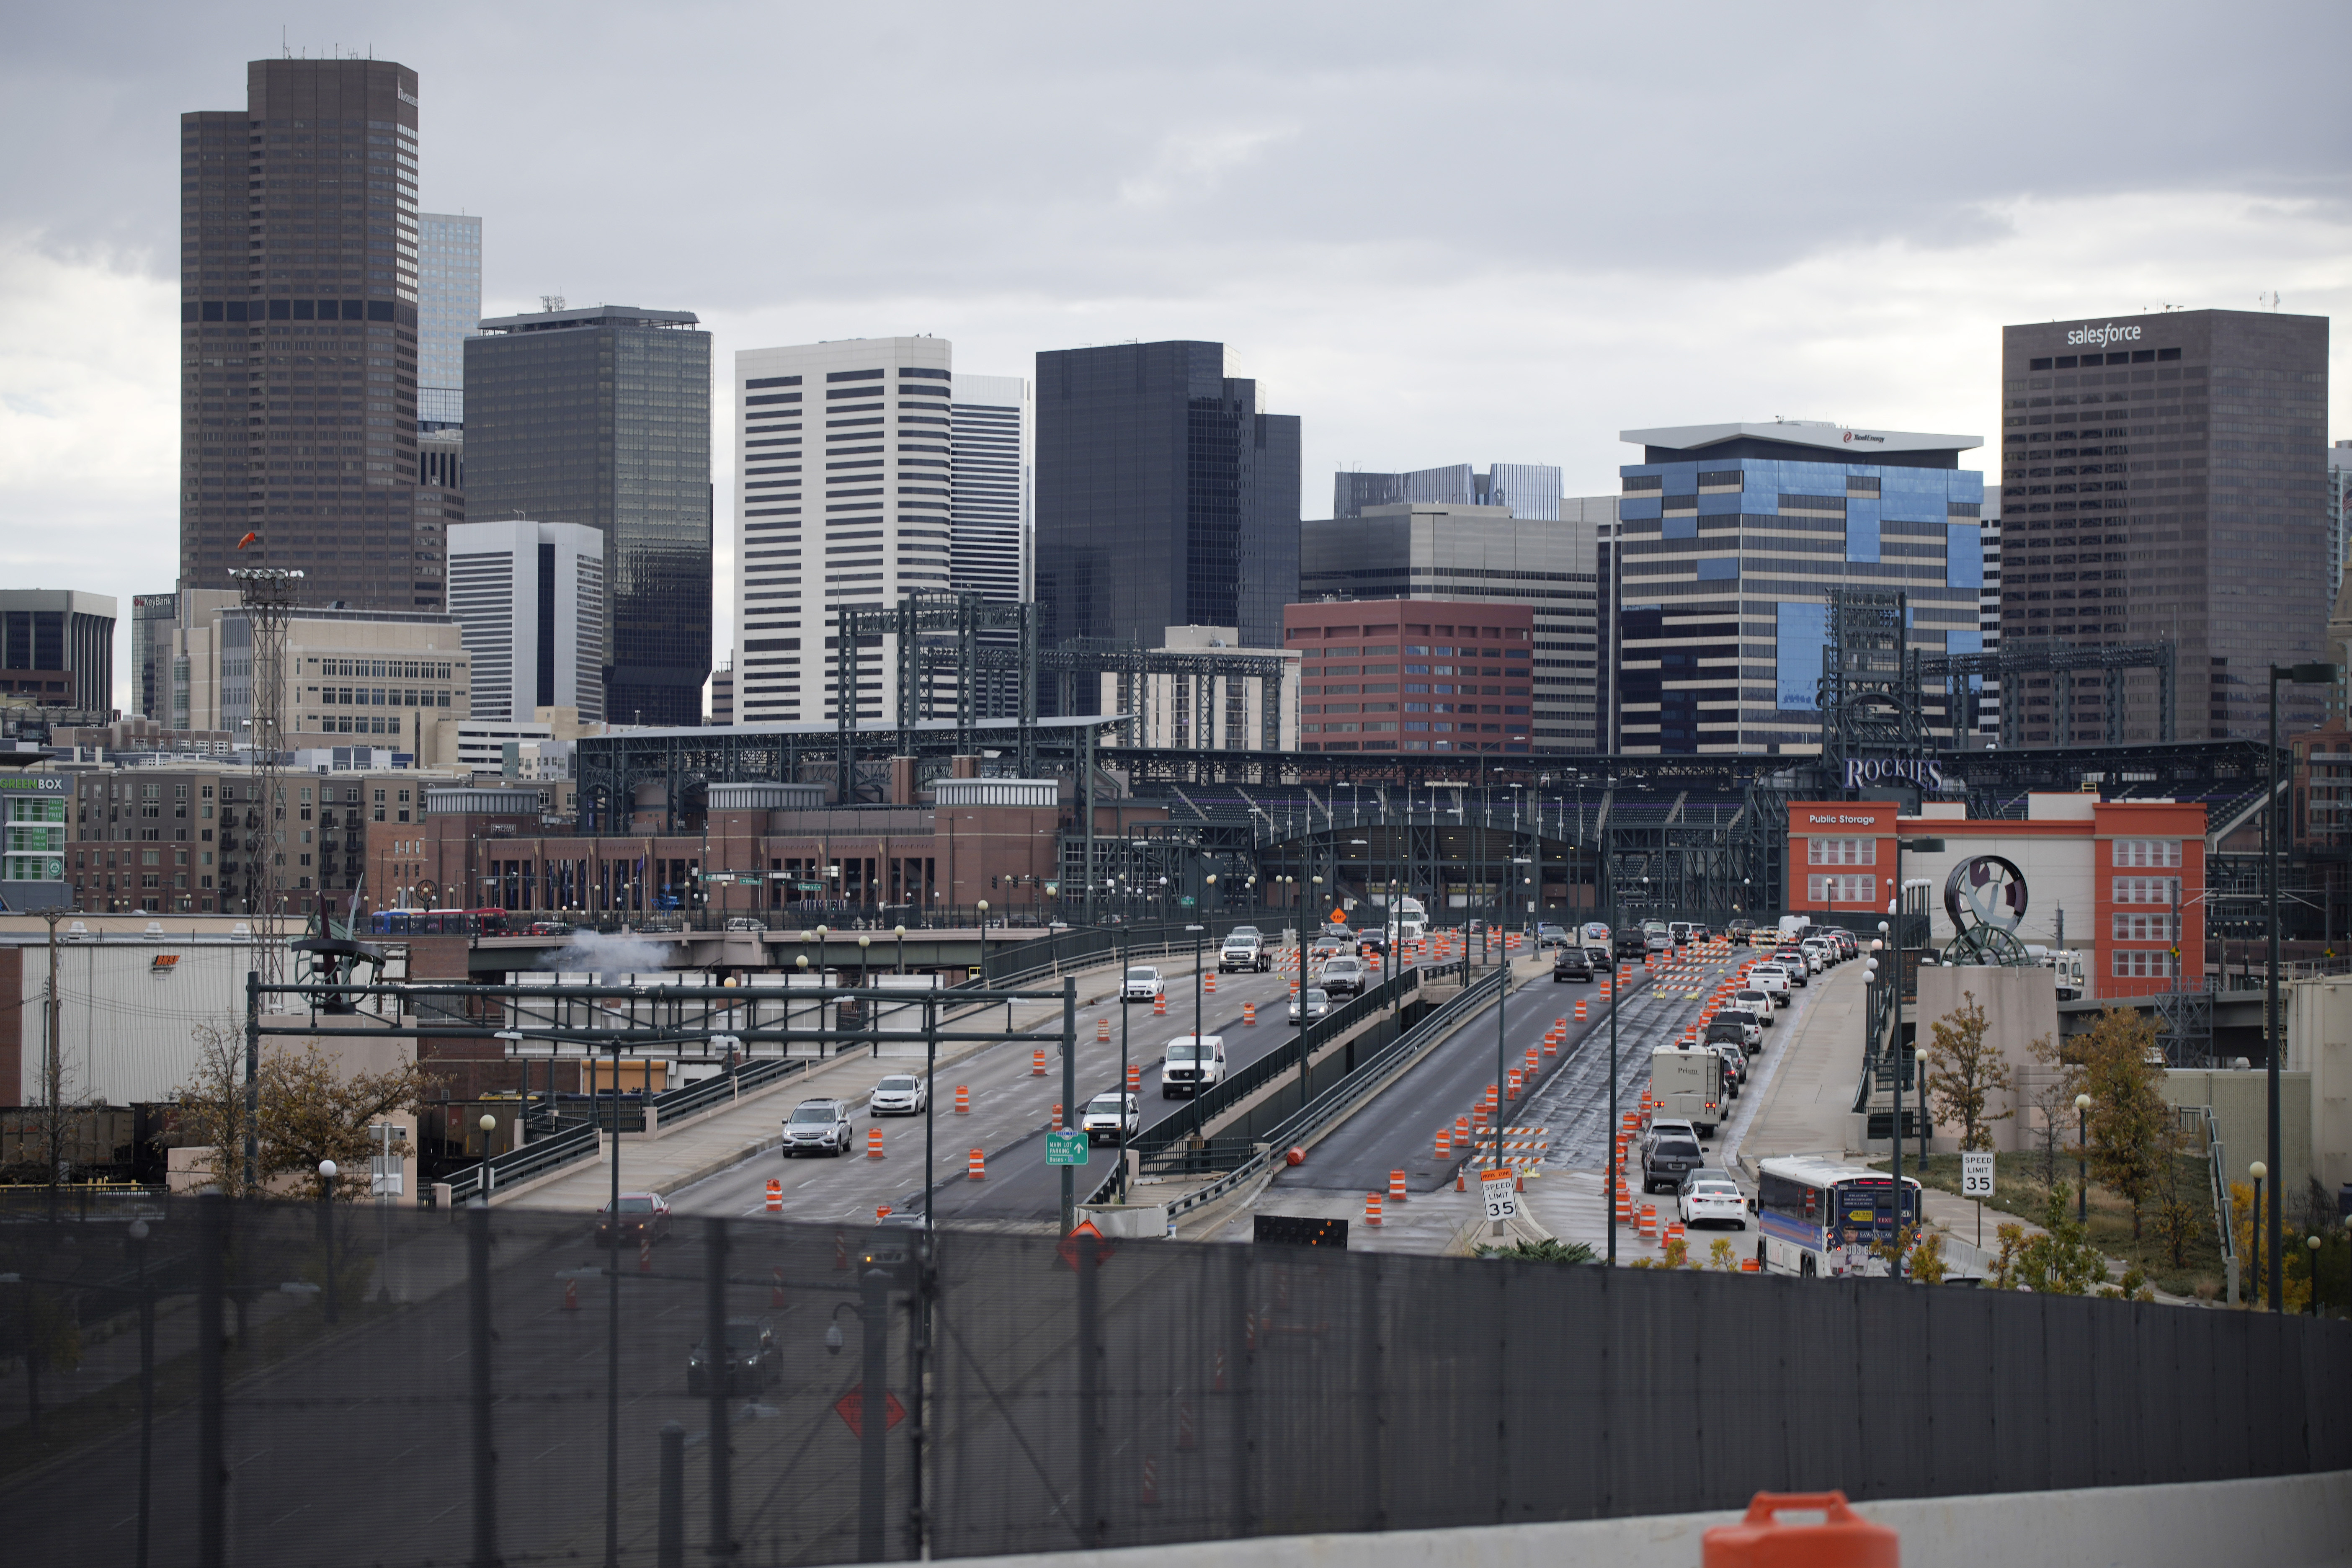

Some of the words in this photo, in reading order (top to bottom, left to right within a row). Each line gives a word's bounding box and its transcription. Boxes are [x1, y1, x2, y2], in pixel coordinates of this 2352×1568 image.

[2068, 322, 2141, 348] salesforce
[144, 596, 171, 609] KeyBank
[1843, 758, 1942, 792] ROCKIES
[1810, 815, 1836, 823] Public
[1839, 815, 1875, 825] Storage
[156, 955, 180, 965] BNSF
[1485, 1181, 1511, 1191] SPEED
[1967, 1177, 1990, 1190] 35
[1489, 1191, 1509, 1200] LIMIT
[1489, 1201, 1514, 1216] 35
